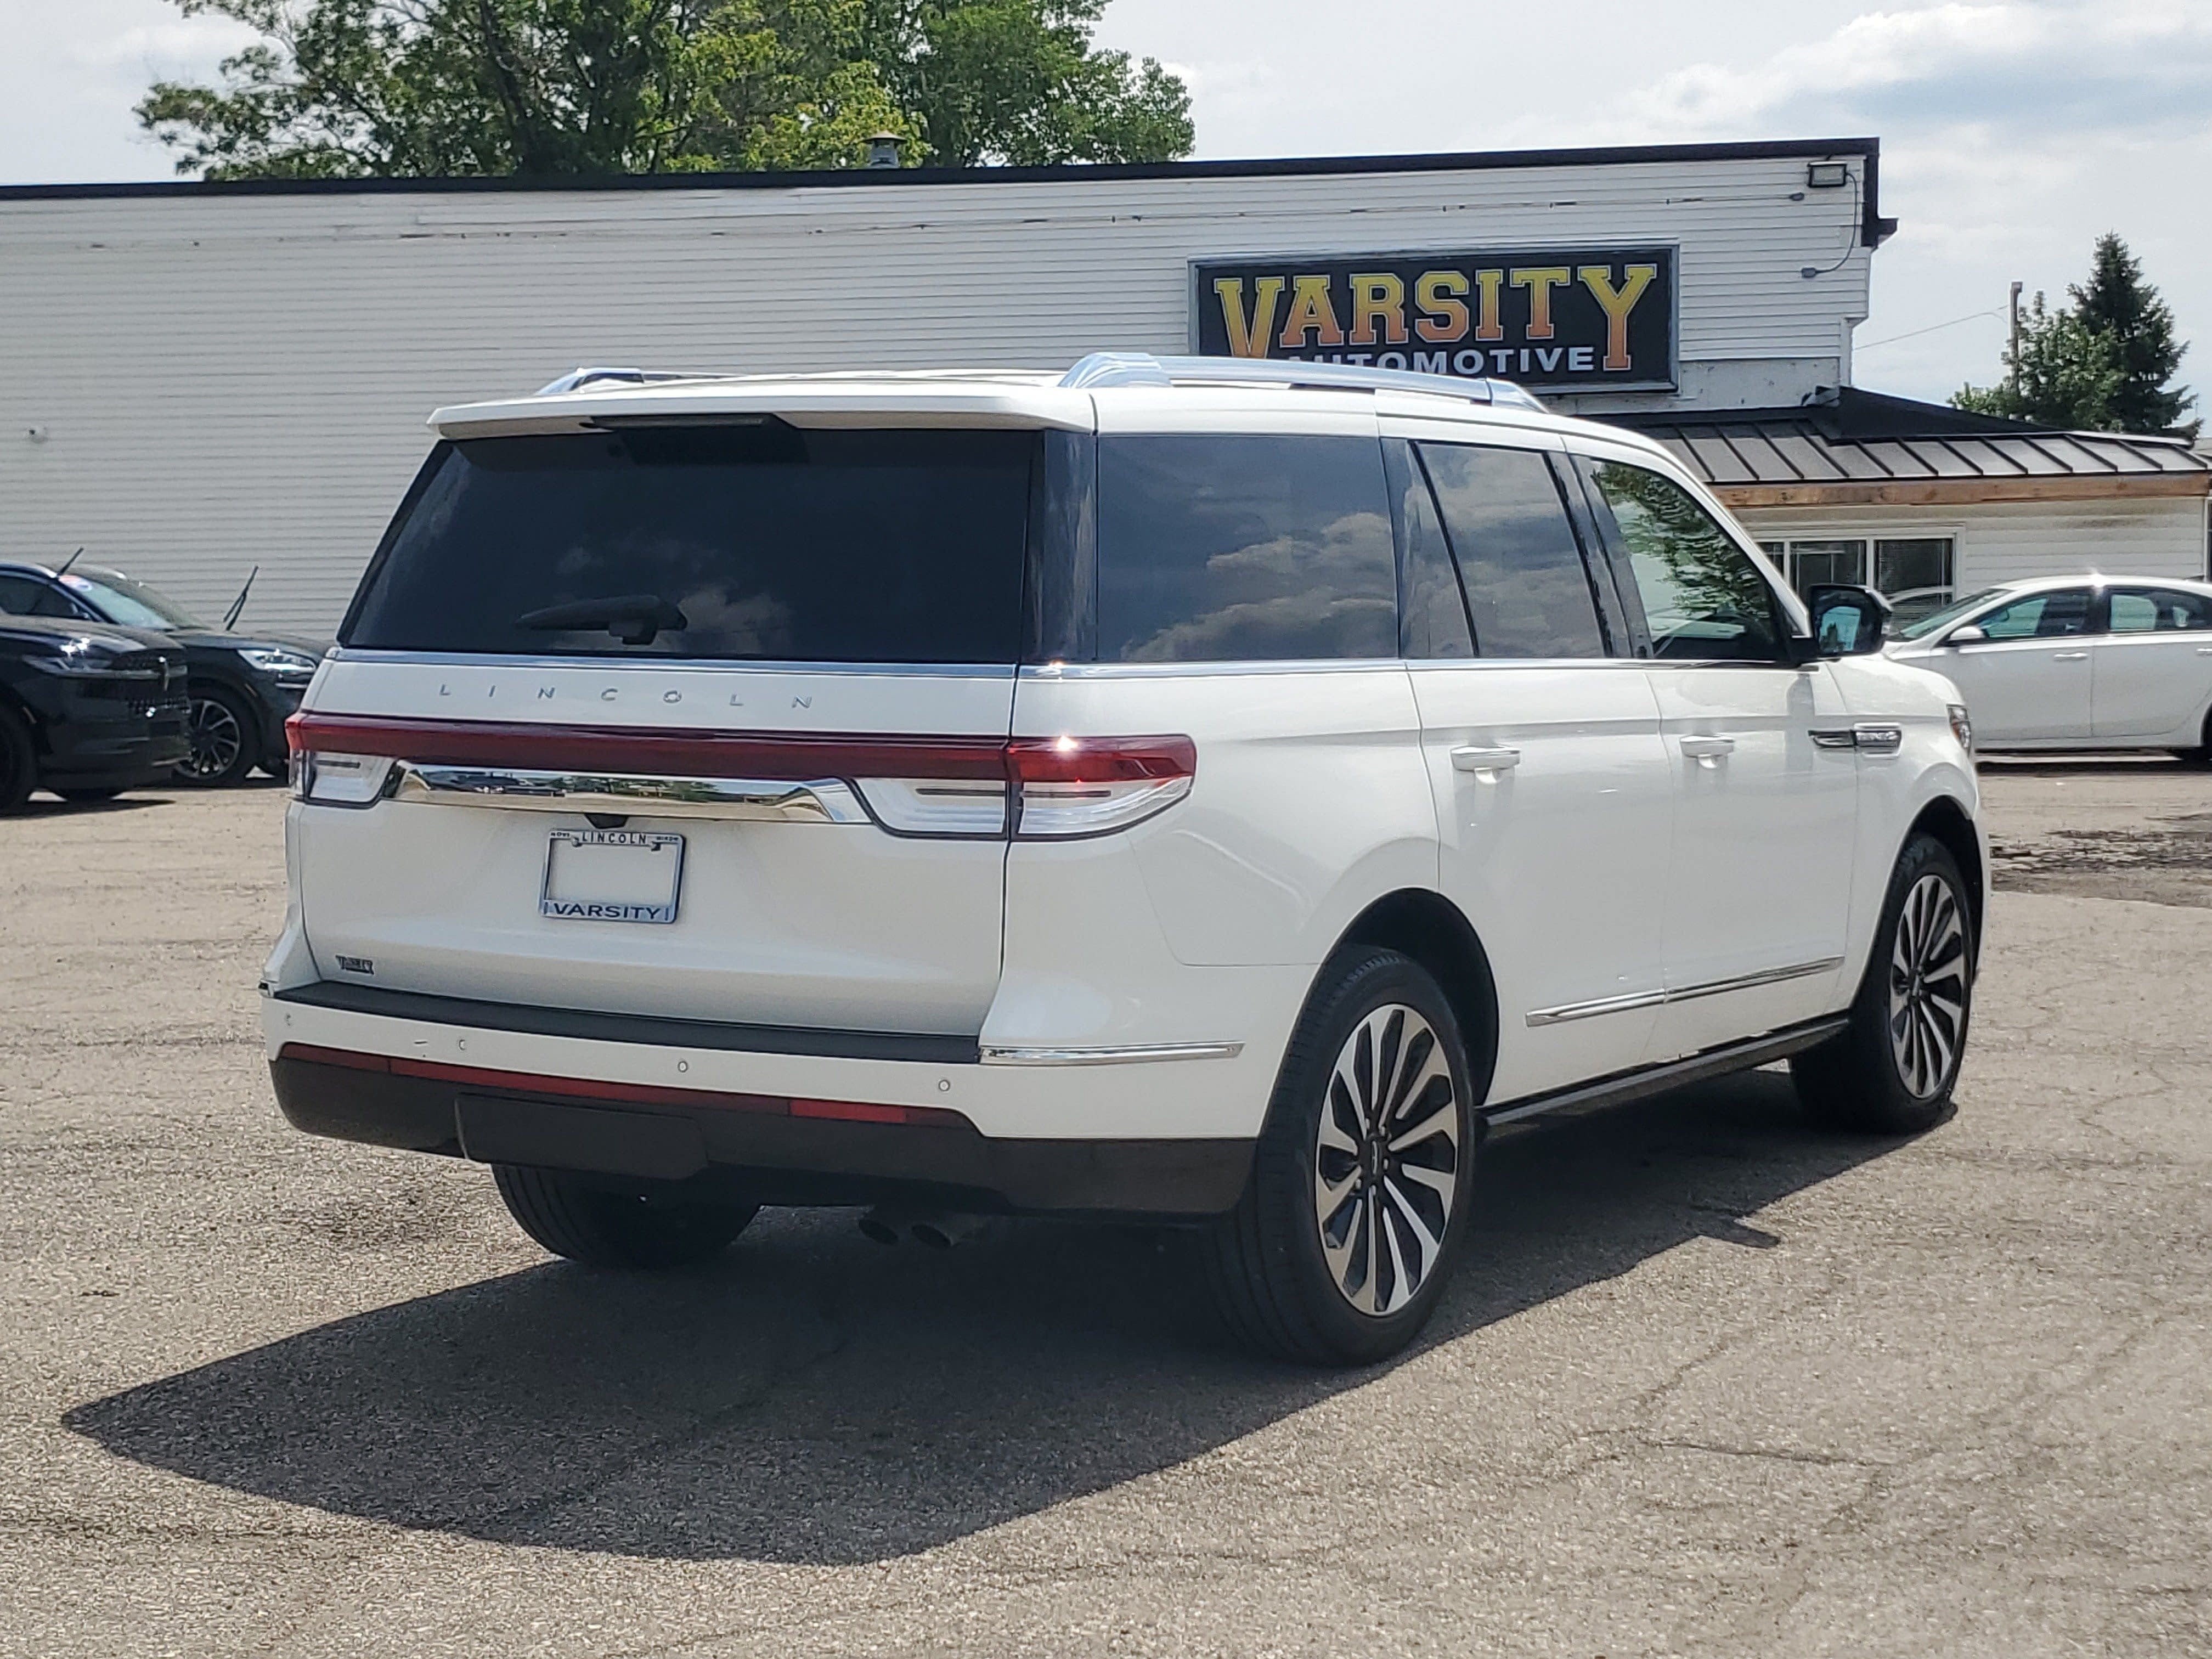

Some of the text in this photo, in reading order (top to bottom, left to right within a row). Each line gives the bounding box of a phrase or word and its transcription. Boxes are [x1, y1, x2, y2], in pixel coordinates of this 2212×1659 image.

[1214, 263, 1657, 371] VARSITY
[1288, 347, 1595, 375] TOMOTIVE
[438, 683, 813, 709] LINCOLN
[582, 832, 647, 844] LINCOLN
[553, 902, 661, 919] VARSITY
